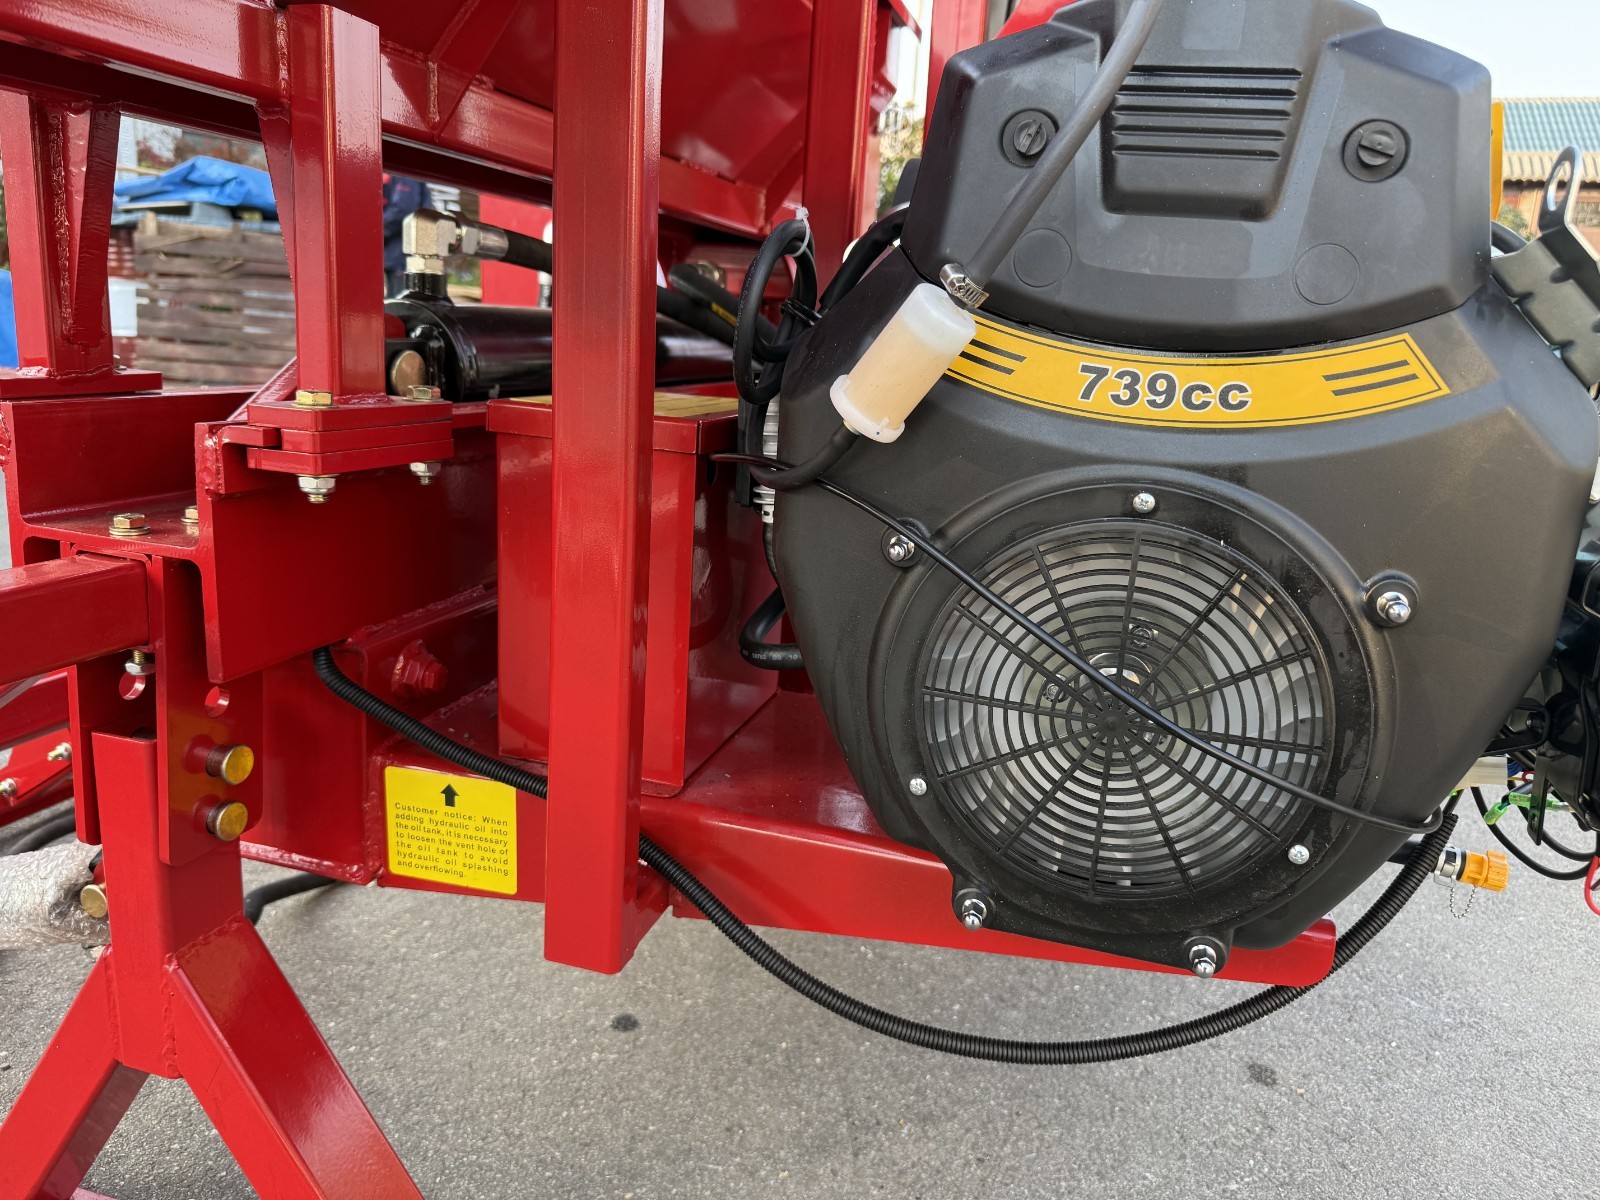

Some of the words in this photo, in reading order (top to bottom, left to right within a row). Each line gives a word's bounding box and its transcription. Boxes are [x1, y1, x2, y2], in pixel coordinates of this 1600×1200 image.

[1076, 362, 1253, 412] 739cc
[395, 802, 438, 815] Customer
[444, 812, 476, 821] notice:
[482, 816, 508, 826] When
[395, 814, 424, 824] adding
[429, 818, 469, 830] hydraulic
[491, 827, 508, 836] into
[396, 822, 408, 830] the
[424, 826, 444, 836] tank,
[464, 833, 508, 846] necessary
[408, 832, 435, 843] loosen
[439, 838, 452, 846] the
[456, 841, 474, 850] vent
[478, 844, 496, 853] hole
[396, 840, 411, 848] the
[437, 847, 458, 856] tank
[481, 855, 508, 865] avoid
[397, 850, 439, 863] hydraulic
[446, 858, 456, 866] oil
[462, 862, 508, 876] splashing
[397, 860, 412, 868] and
[415, 863, 466, 878] overflowing.
